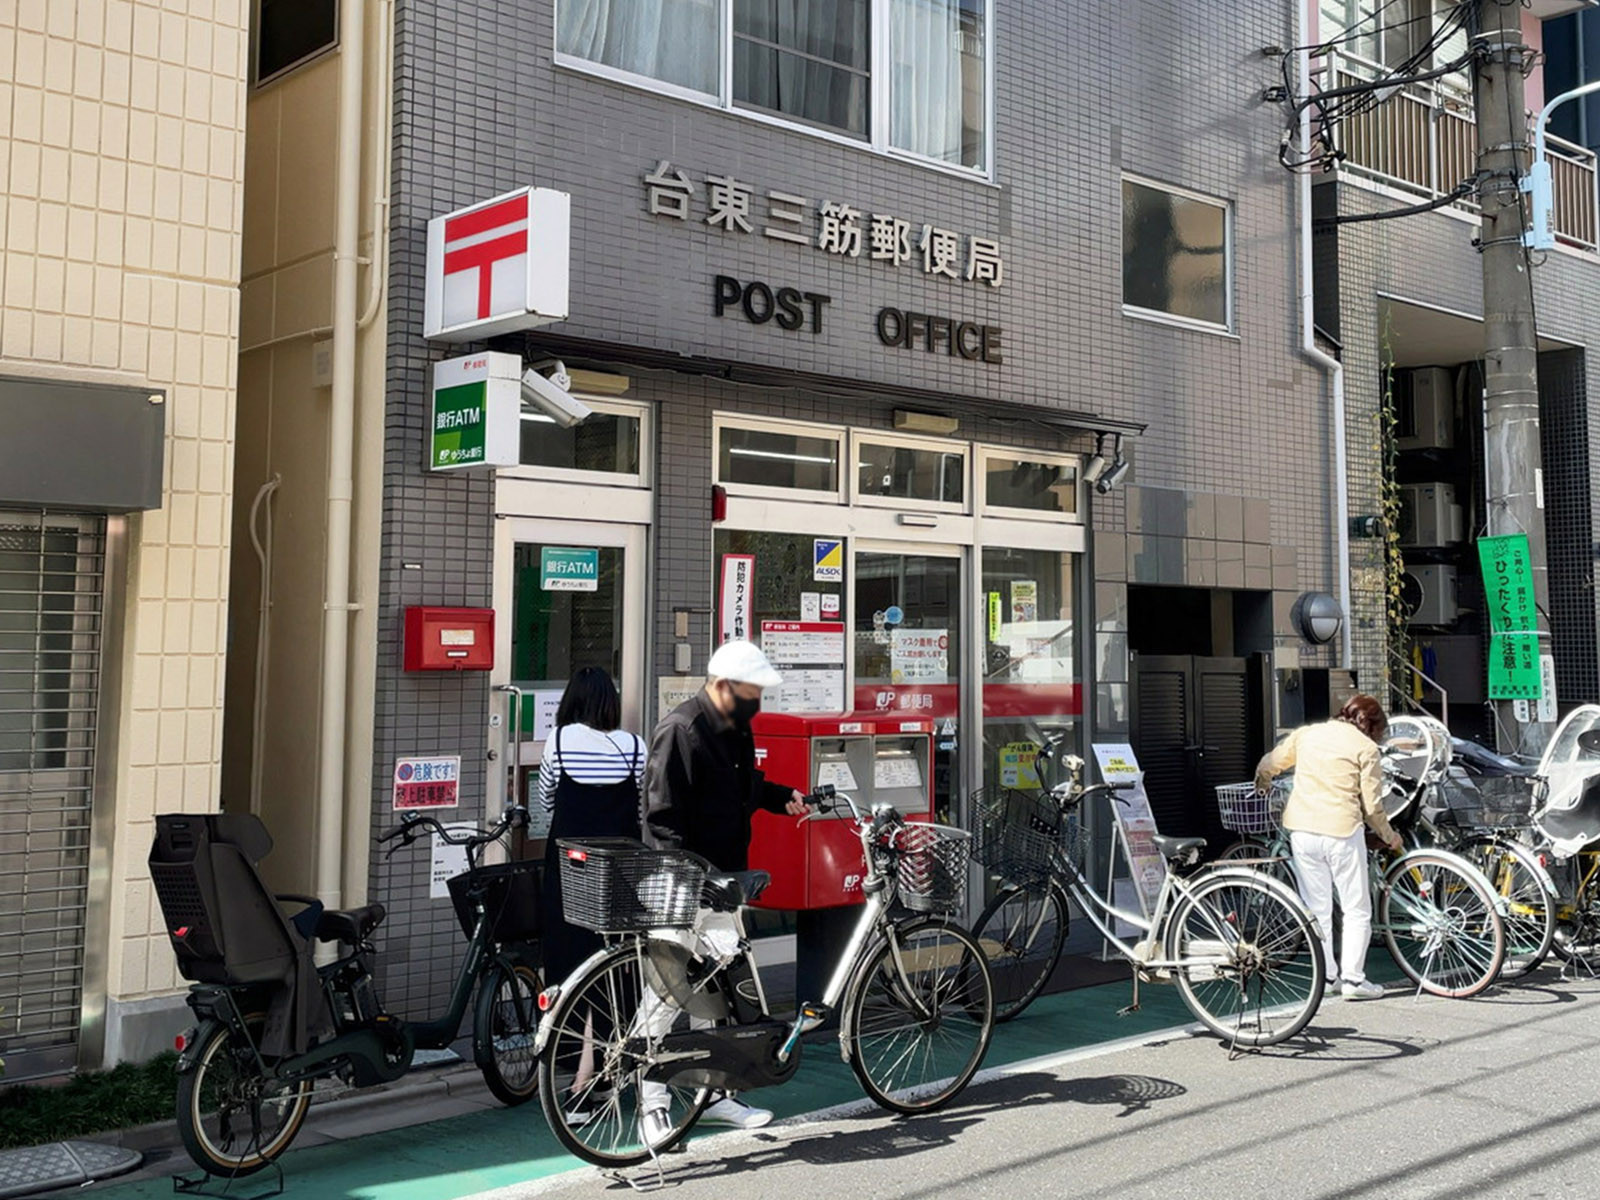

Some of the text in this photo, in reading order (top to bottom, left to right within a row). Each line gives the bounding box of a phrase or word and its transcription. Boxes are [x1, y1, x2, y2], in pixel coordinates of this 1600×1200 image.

[644, 159, 1003, 287] 台東三筋郵便局
[713, 274, 1003, 365] POST OFFICE
[436, 406, 481, 430] 銀行ATM
[545, 560, 594, 574] 銀行ATM
[815, 567, 841, 576] ALSOK
[734, 561, 747, 641] 防犯カメラ作動
[1495, 559, 1517, 683] ひったくりに注意！
[900, 693, 934, 710] 郵便局
